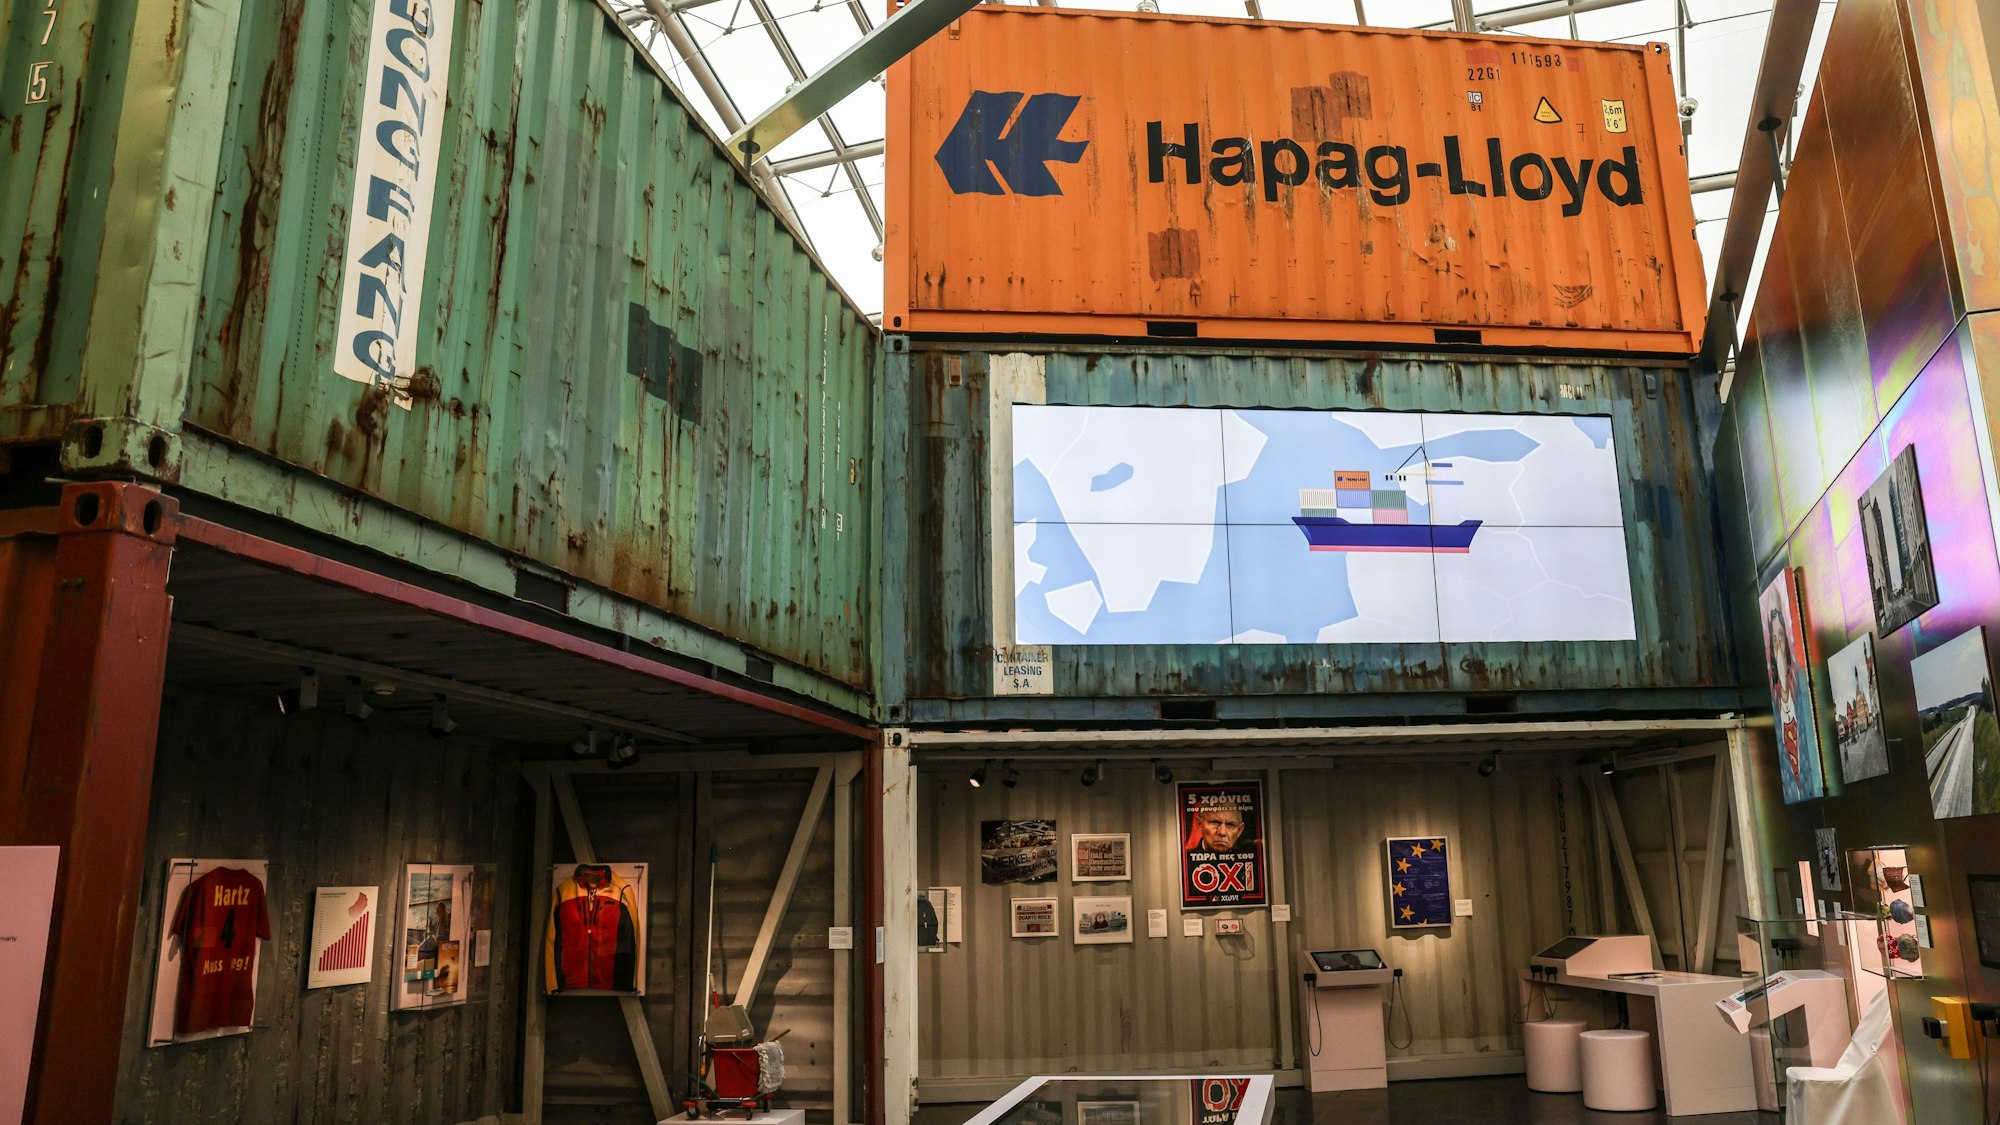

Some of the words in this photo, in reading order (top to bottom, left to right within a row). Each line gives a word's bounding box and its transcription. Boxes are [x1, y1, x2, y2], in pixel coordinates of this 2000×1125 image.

[1511, 52, 1562, 68] 111593
[30, 64, 49, 100] 5
[1467, 66, 1500, 81] 22G1
[1146, 120, 1643, 217] Hapag-Lloyd
[353, 174, 415, 380] FANG
[1003, 665, 1042, 676] LEASING
[1013, 678, 1033, 688] S.A.
[1188, 793, 1197, 805] 5
[1200, 791, 1252, 807] χρόνια
[1561, 837, 1574, 924] 217987
[213, 884, 250, 907] Hartz
[220, 909, 236, 949] 4
